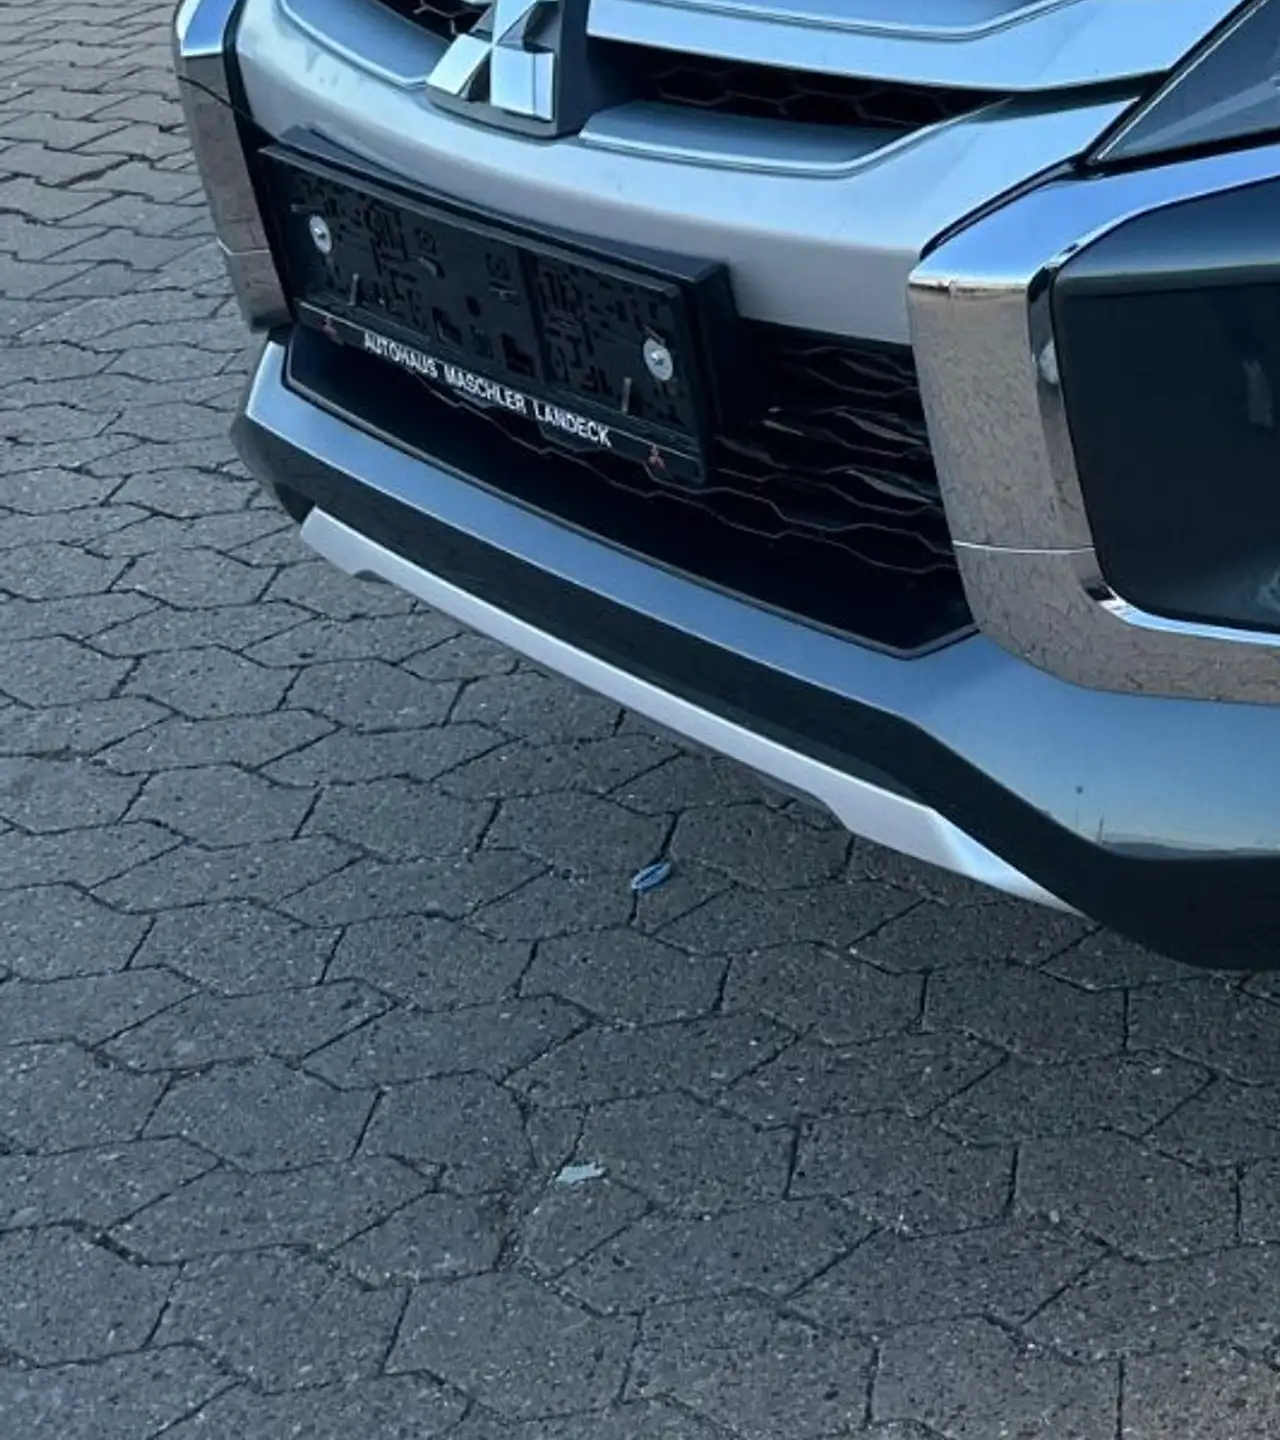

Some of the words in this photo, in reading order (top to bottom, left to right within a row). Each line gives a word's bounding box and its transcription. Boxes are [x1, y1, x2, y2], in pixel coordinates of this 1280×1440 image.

[363, 328, 439, 380] AUTOHAUS
[443, 364, 528, 415] MASCHLER
[532, 398, 613, 449] LANDECK
